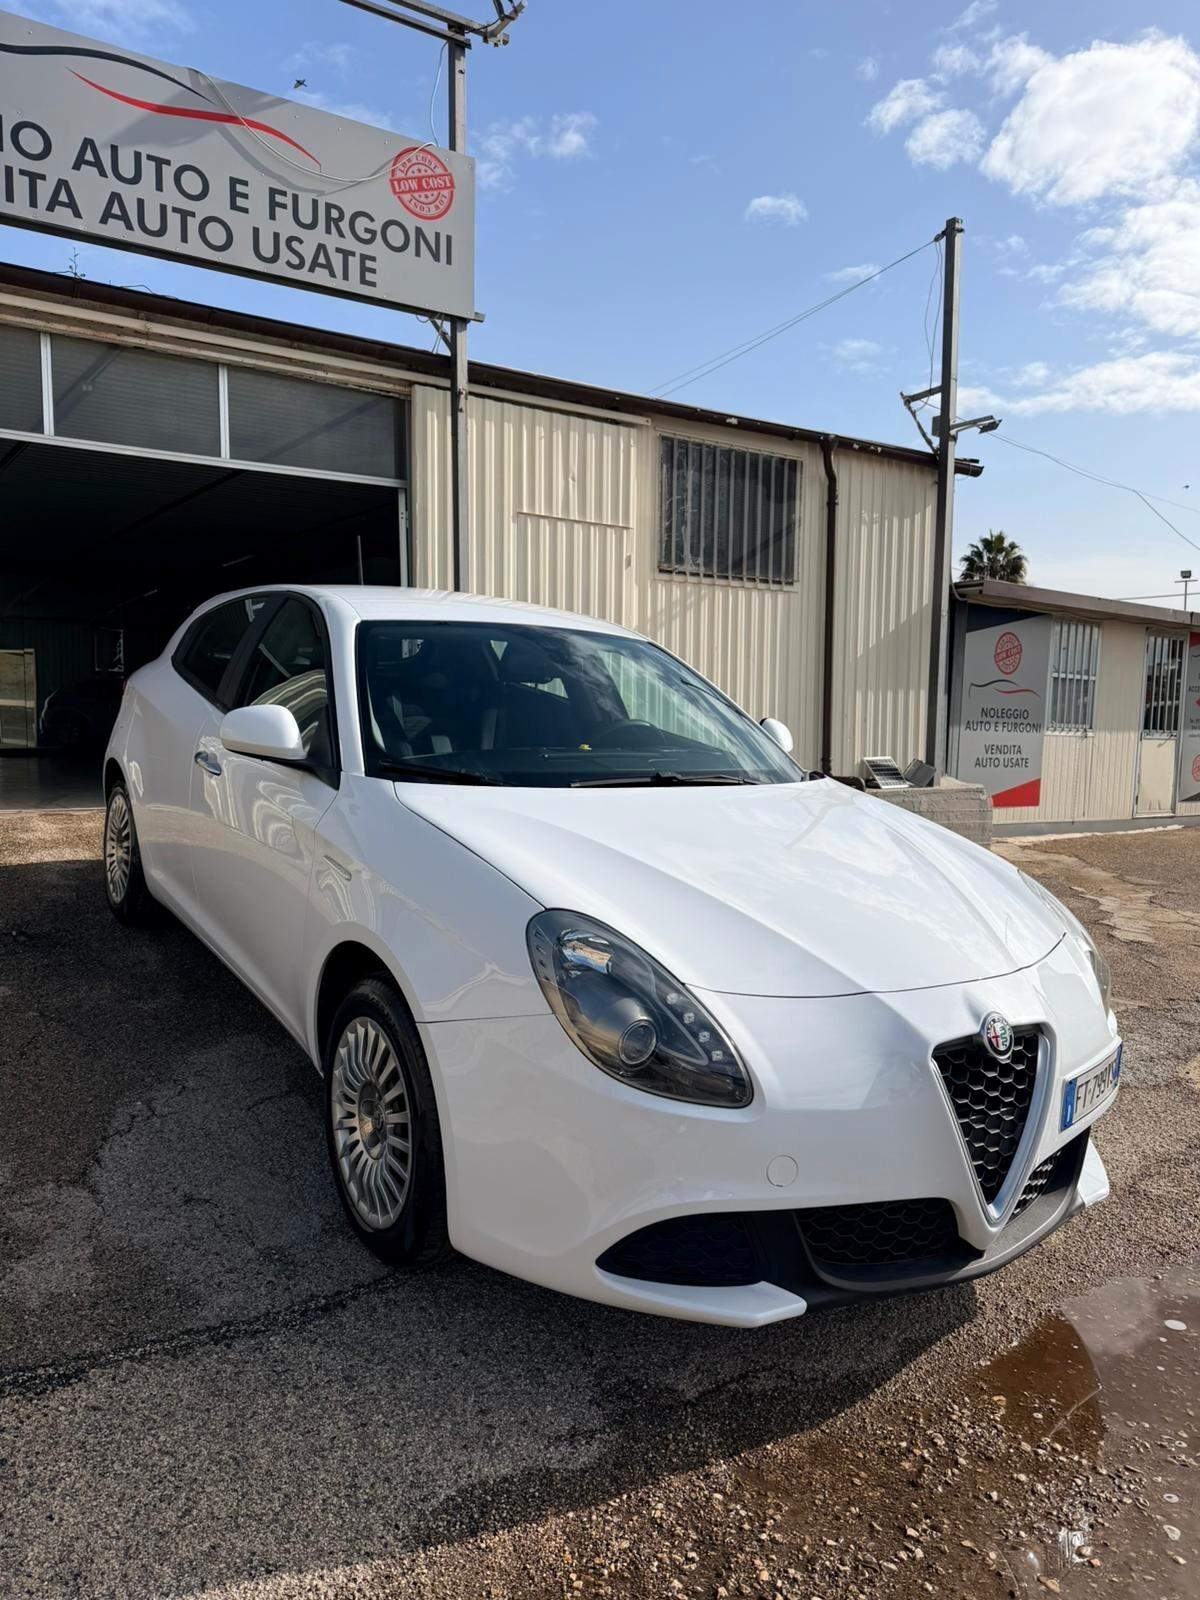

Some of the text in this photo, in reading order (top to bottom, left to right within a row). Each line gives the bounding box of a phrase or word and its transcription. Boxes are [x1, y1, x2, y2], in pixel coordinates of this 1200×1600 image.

[393, 175, 452, 193] LOW COST
[71, 137, 210, 202] AUTO
[229, 176, 250, 214] E
[268, 186, 453, 266] FURGONI
[99, 190, 234, 252] AUTO
[253, 226, 378, 288] USATE
[981, 707, 1030, 720] NOLEGGIO
[965, 720, 1042, 733] AUTO E FURGONI
[984, 744, 1023, 755] VENDITA
[974, 757, 1030, 768] AUTO USATE
